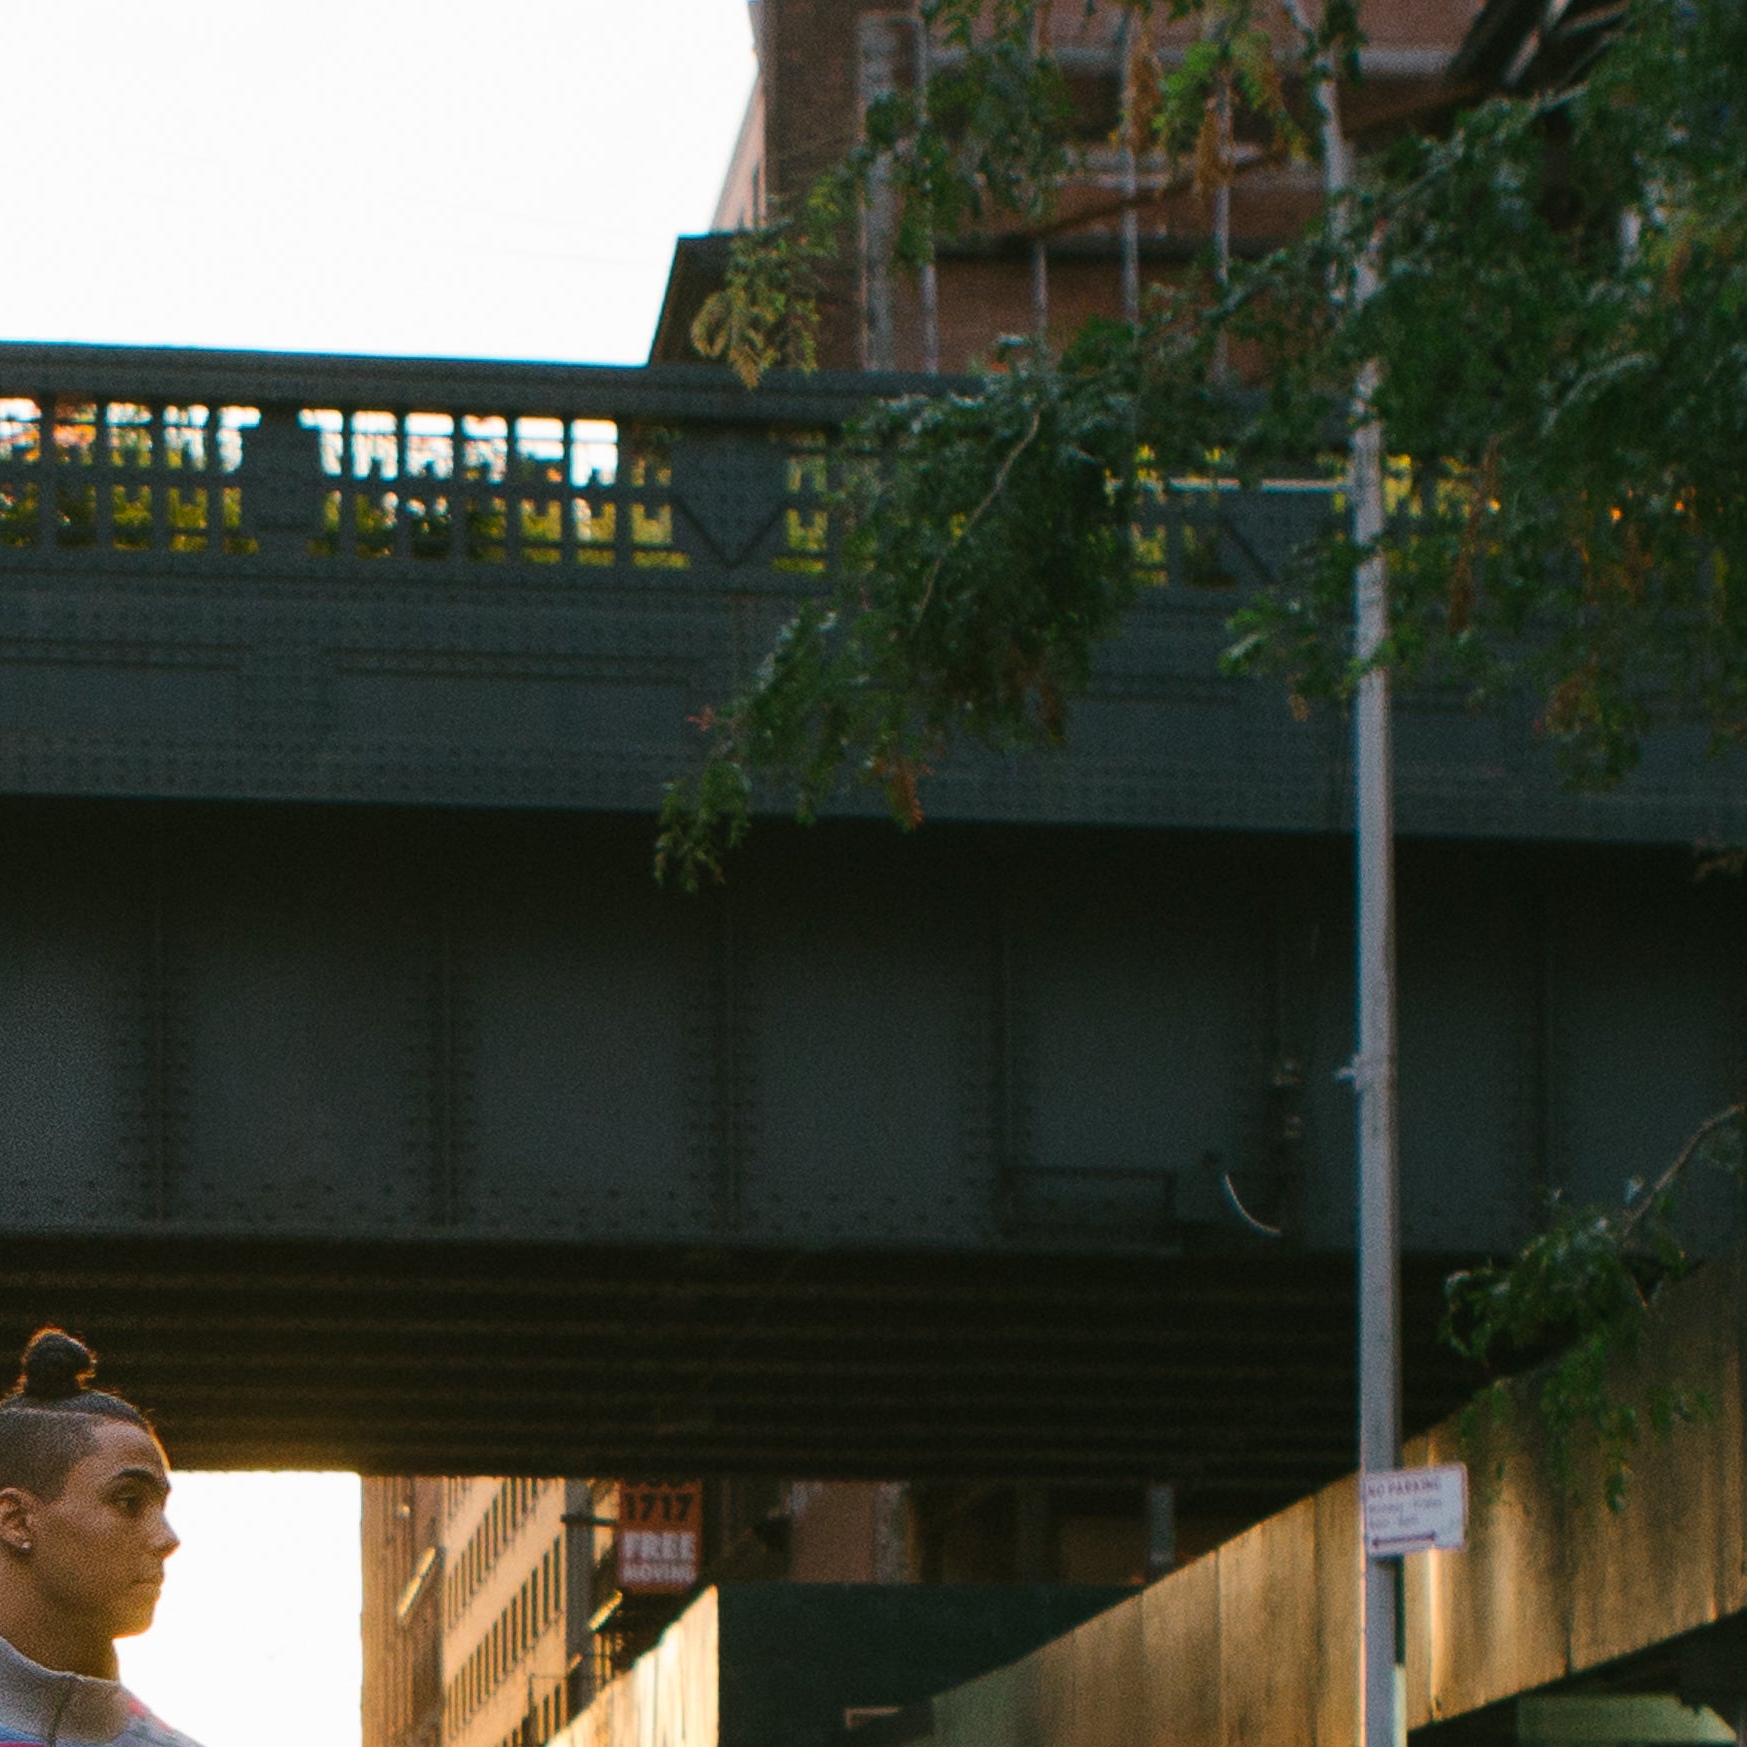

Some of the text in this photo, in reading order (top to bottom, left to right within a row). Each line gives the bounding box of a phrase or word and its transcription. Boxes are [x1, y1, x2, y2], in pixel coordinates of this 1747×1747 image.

[1368, 1477, 1439, 1498] NO PARKING
[625, 1492, 693, 1521] 1717
[623, 1530, 696, 1560] FREE
